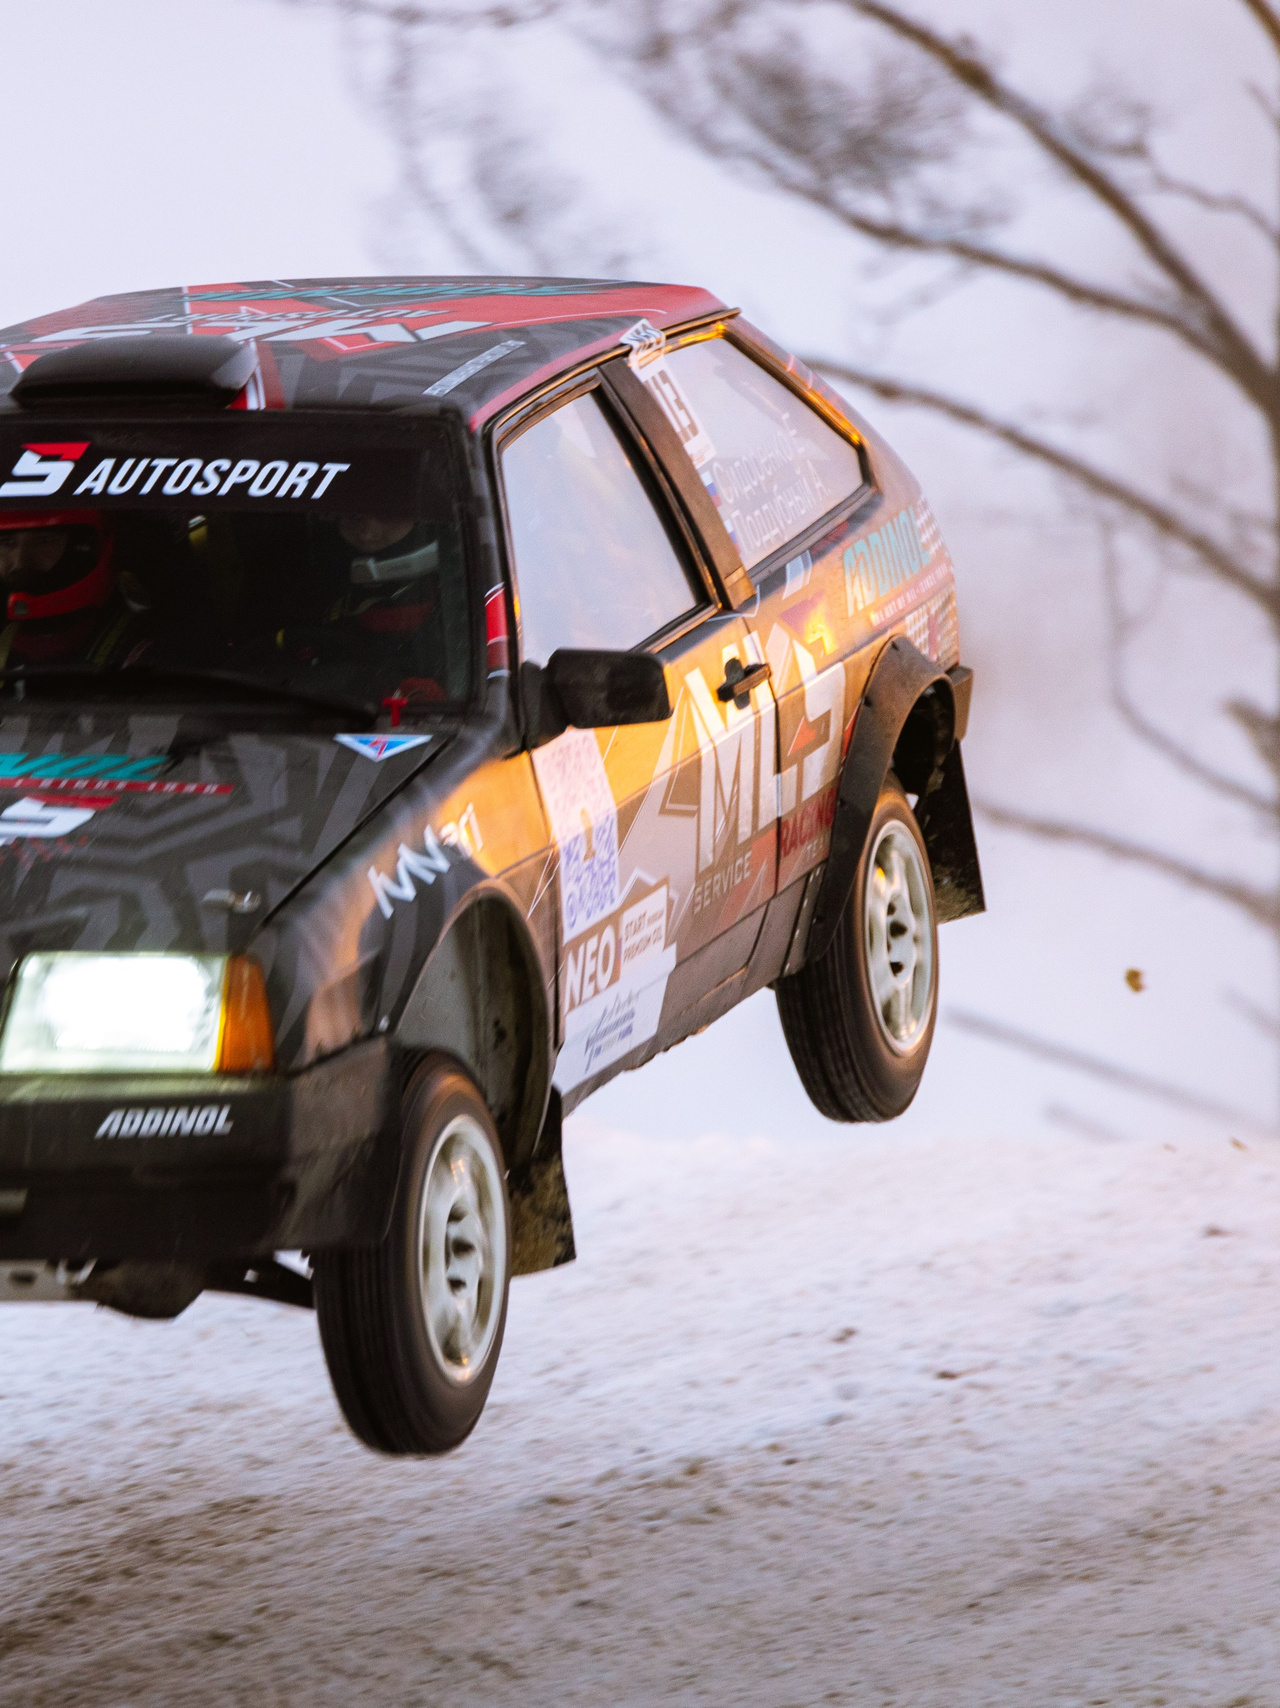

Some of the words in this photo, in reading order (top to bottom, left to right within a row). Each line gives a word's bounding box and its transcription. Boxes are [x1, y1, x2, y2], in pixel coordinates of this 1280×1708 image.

[72, 457, 350, 499] AUTOSPORT
[694, 851, 751, 916] SERVICE
[564, 924, 616, 1014] NEO
[94, 1103, 234, 1139] ADDINOL
